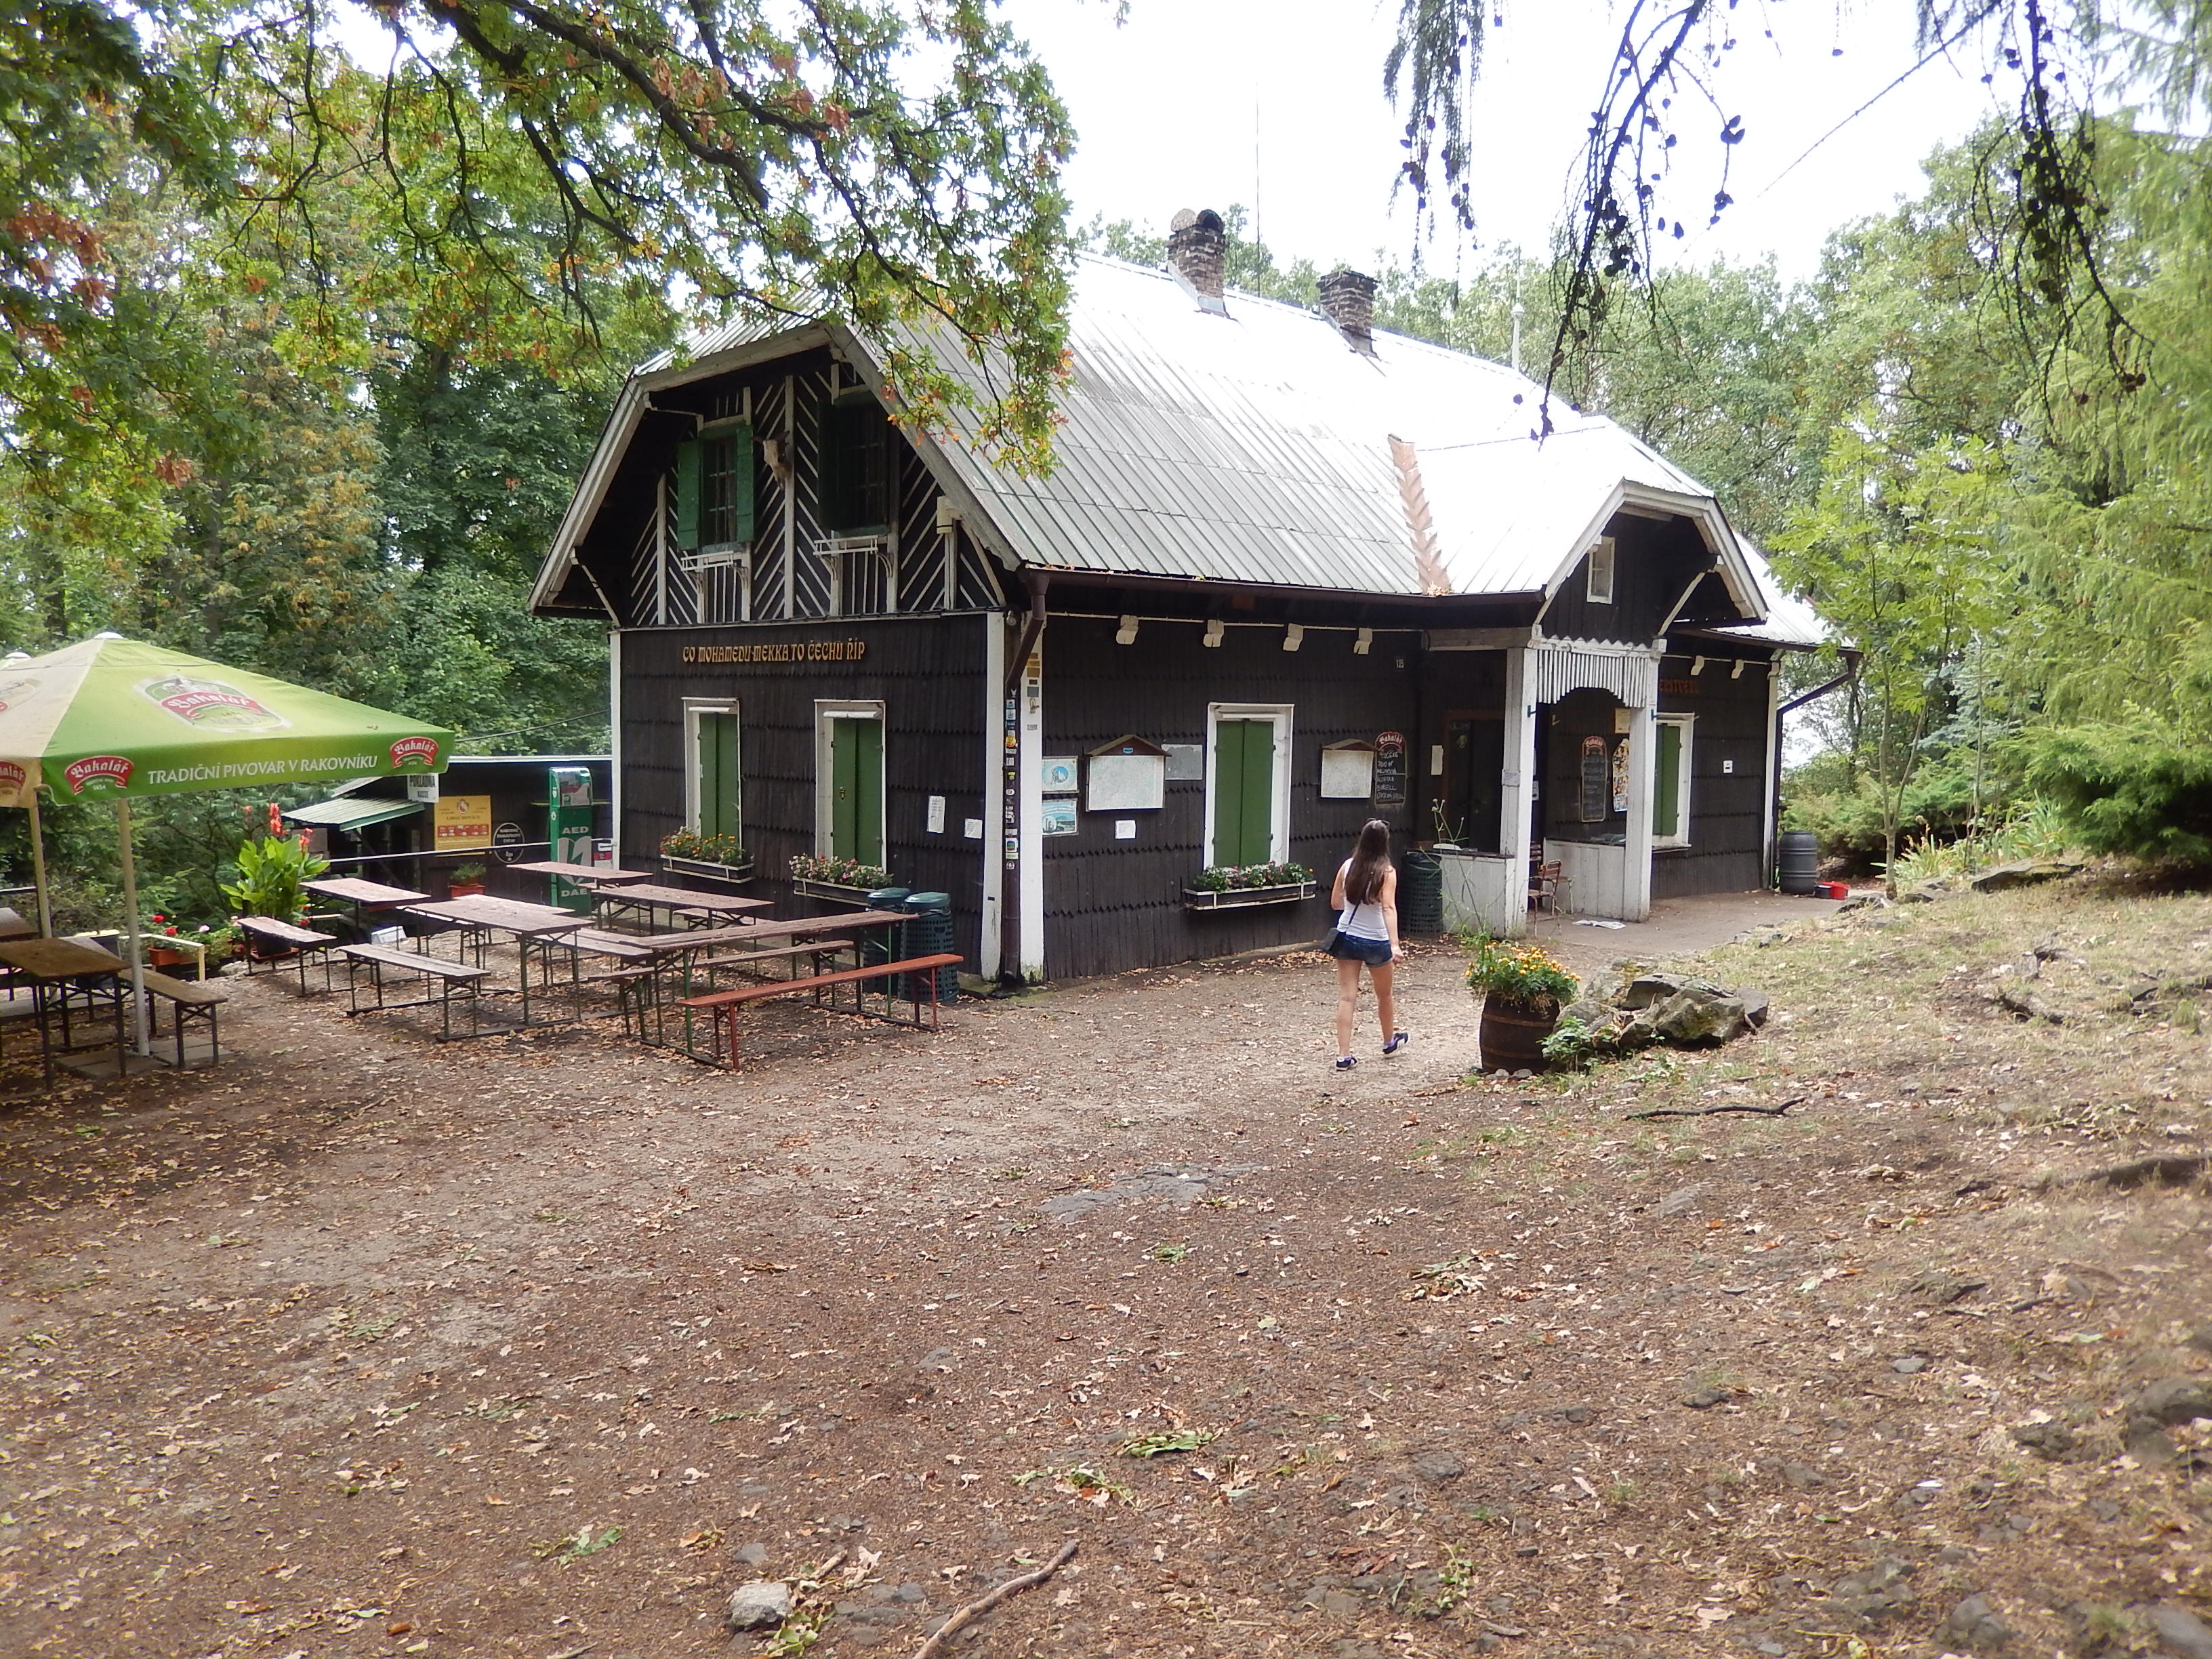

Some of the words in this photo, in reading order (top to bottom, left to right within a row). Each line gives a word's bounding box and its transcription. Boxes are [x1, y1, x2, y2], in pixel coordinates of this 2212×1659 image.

[683, 647, 695, 662] CO
[792, 643, 804, 661] TO
[846, 637, 865, 660] ŘÍP
[168, 693, 251, 710] Bakalář
[394, 740, 435, 755] Bakalář
[70, 760, 129, 778] Bakalář
[147, 762, 220, 785] TRADIČNÍ
[224, 760, 285, 778] PIVOVAR
[288, 759, 299, 772] V
[300, 754, 378, 772] RAKOVNÍKU
[562, 826, 589, 834] AED
[560, 888, 588, 897] DAE
